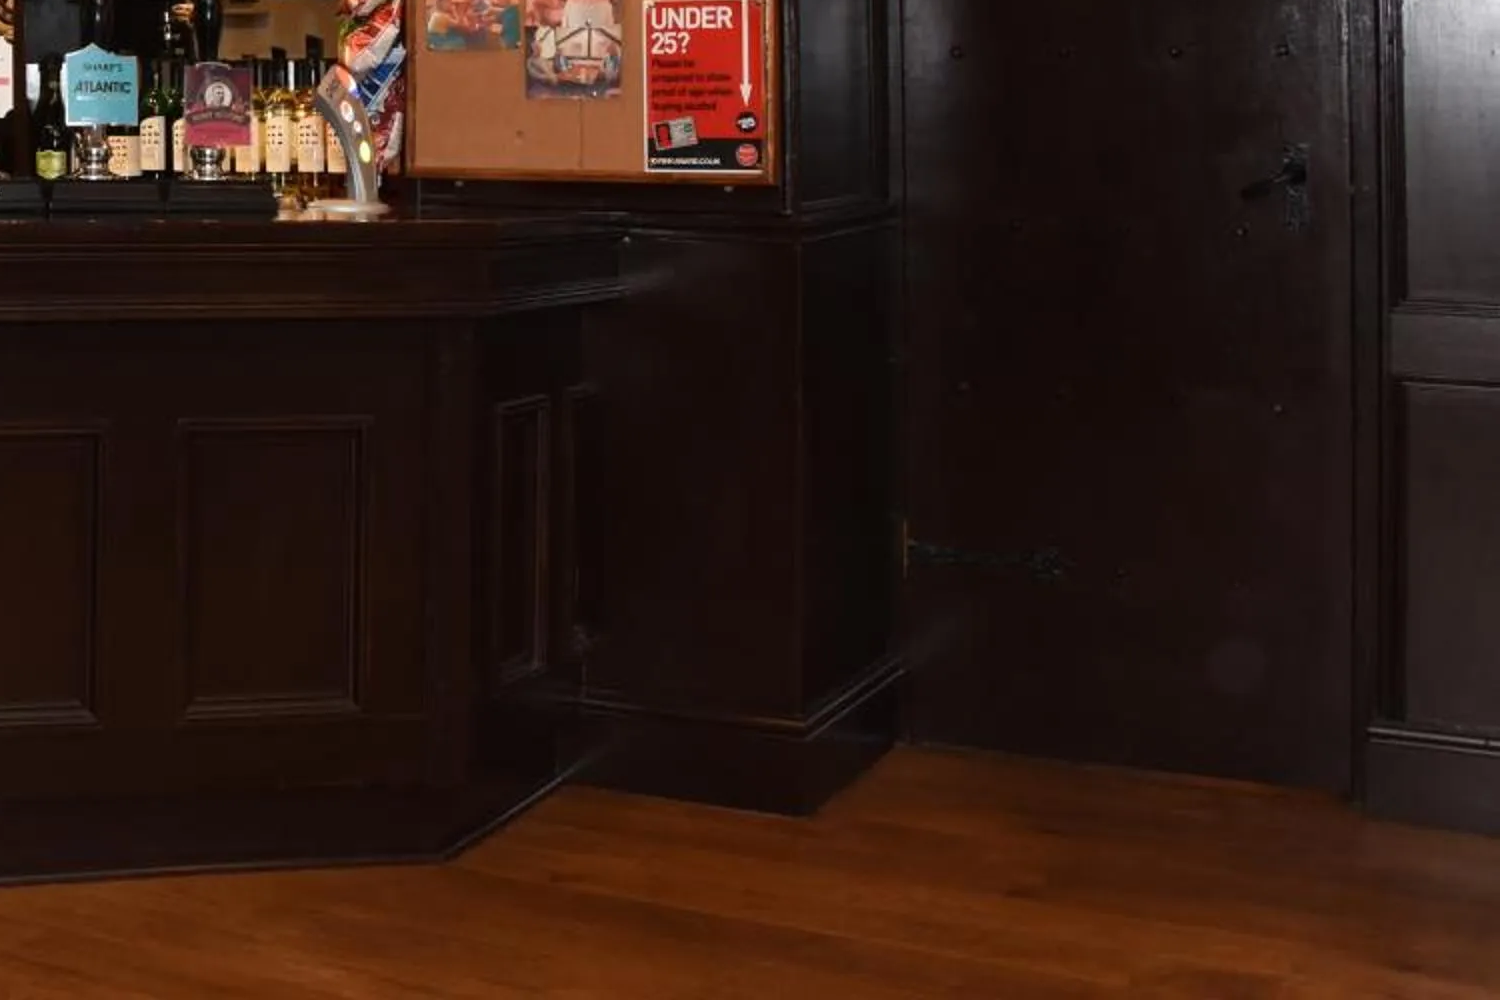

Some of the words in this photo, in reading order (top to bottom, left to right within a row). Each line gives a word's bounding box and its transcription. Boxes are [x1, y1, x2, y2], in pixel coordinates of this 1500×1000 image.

[651, 6, 733, 29] UNDER
[651, 31, 691, 55] 25?
[74, 80, 132, 94] ATLANTIC
